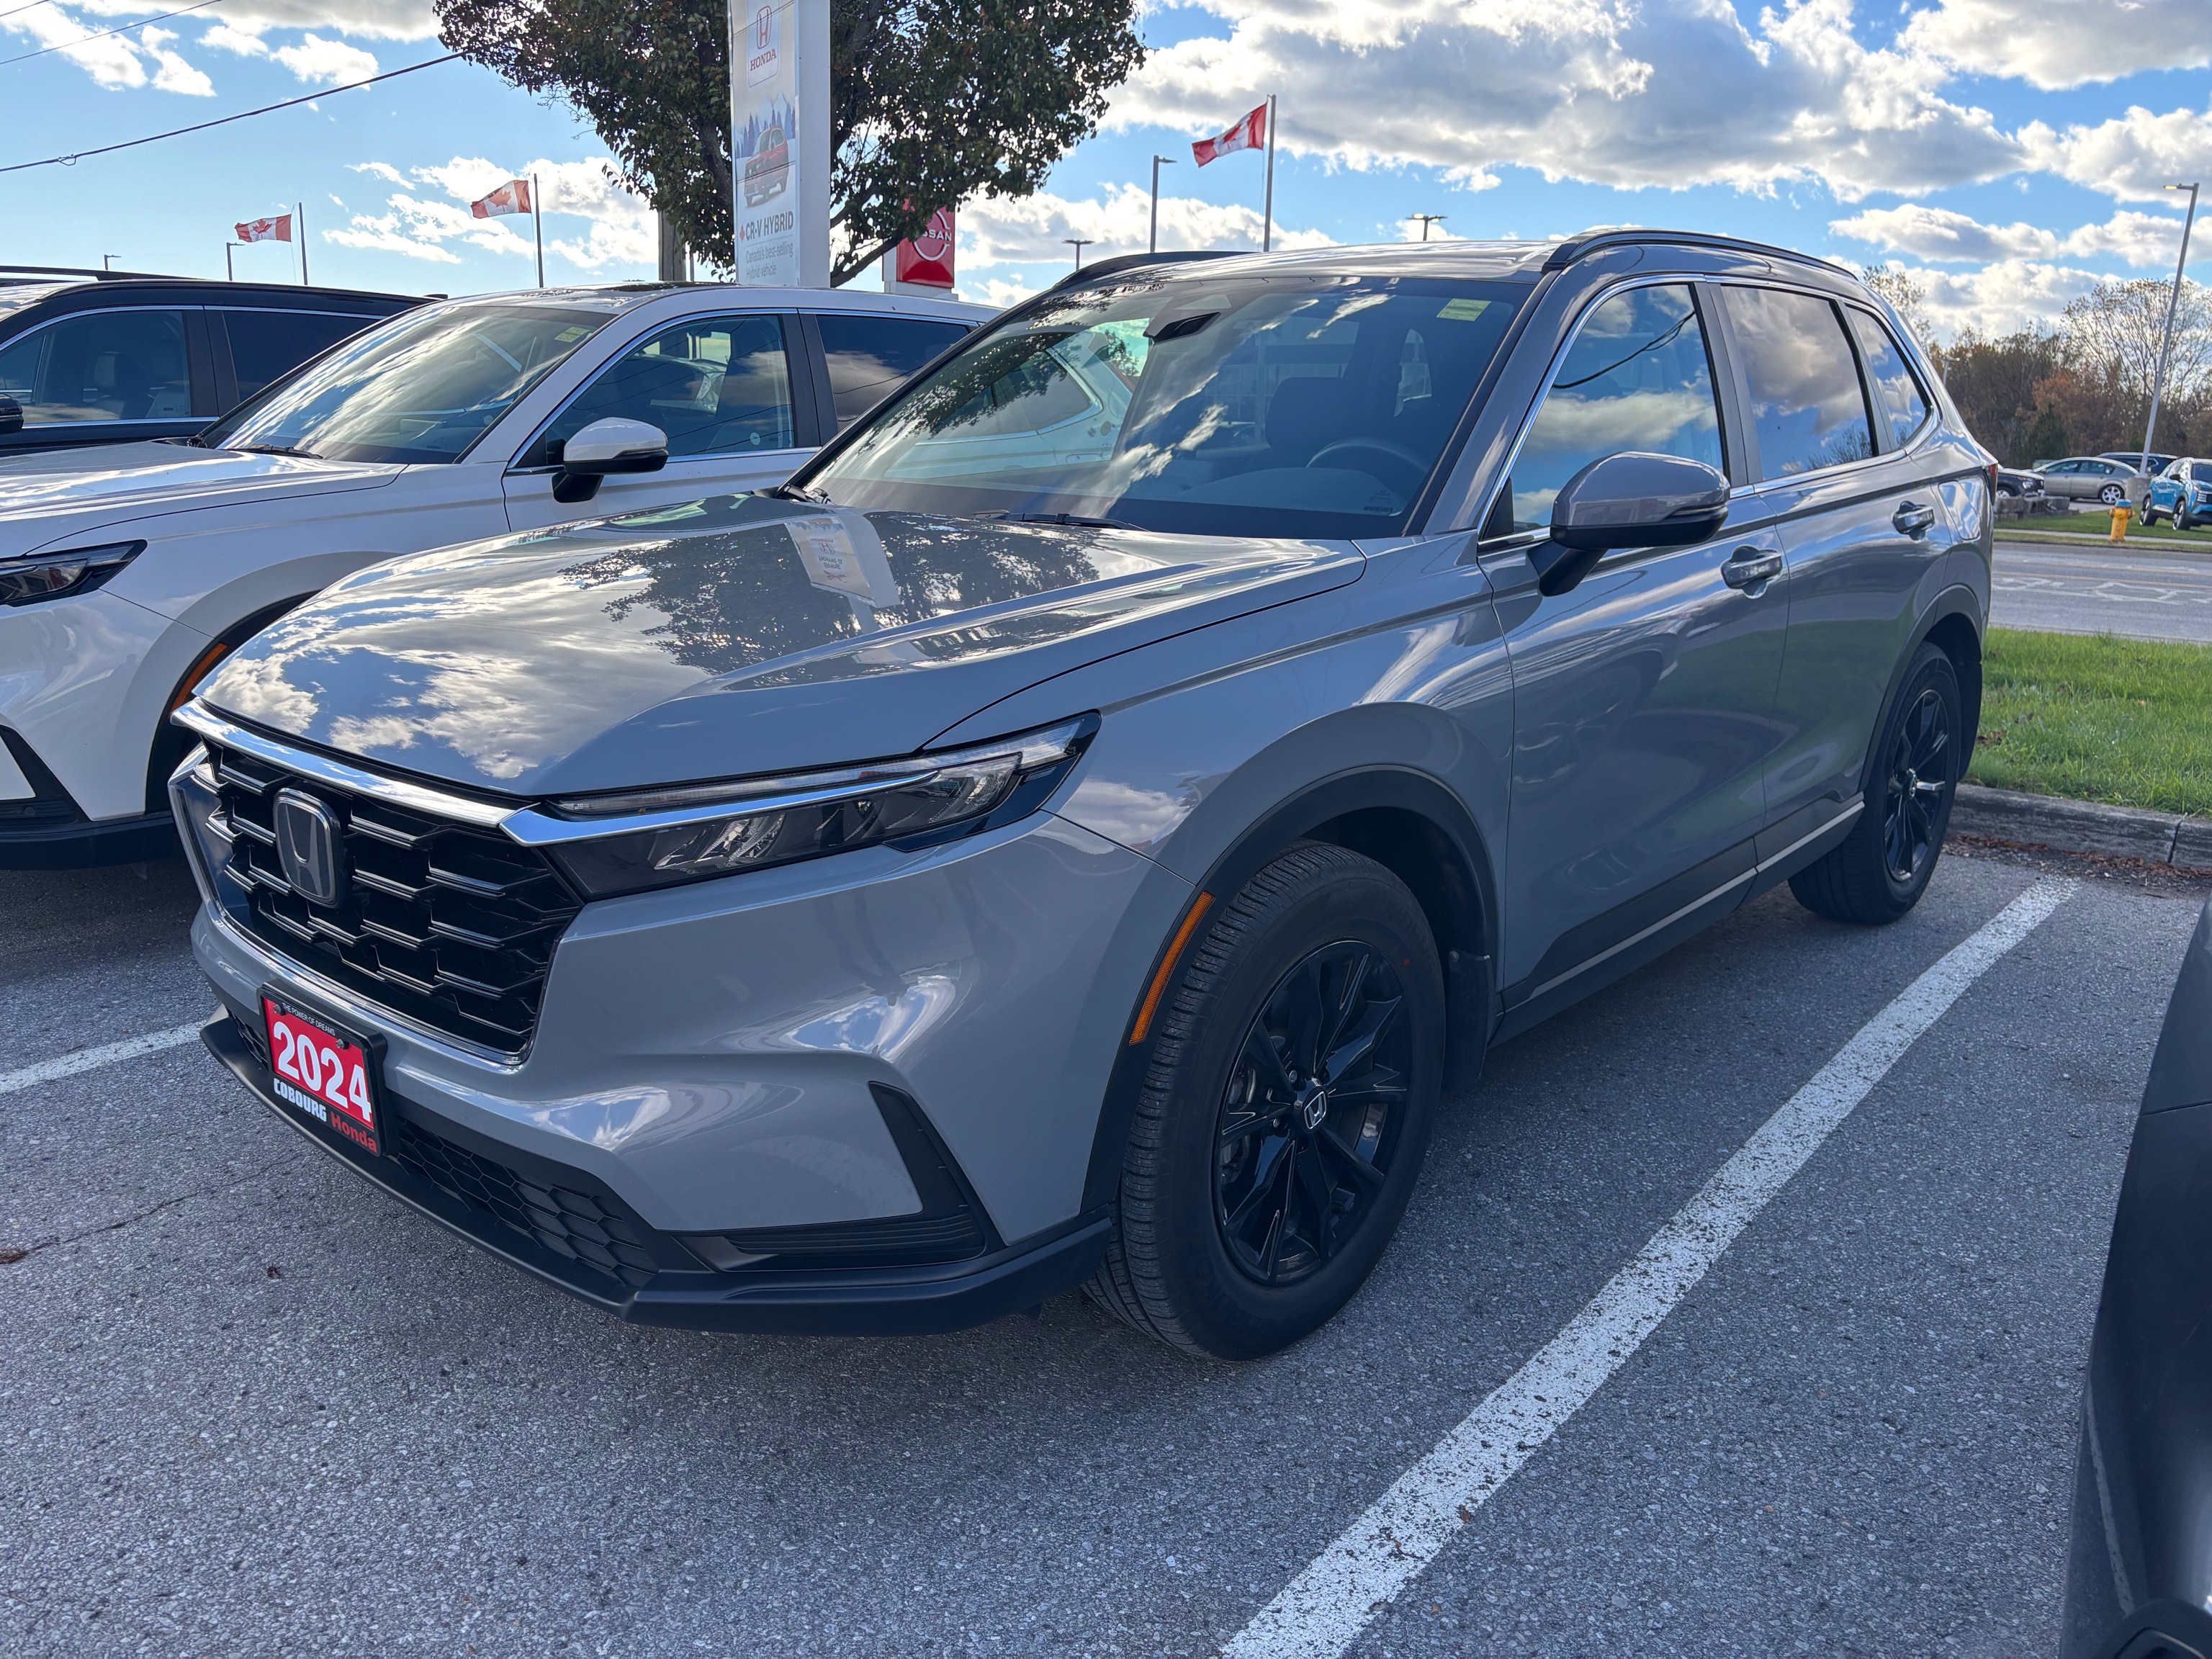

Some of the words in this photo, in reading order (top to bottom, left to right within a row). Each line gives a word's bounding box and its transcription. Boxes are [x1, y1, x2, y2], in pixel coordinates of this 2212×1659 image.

[750, 48, 777, 71] HONDA
[764, 211, 793, 236] HYBRID
[746, 246, 765, 264] Canada's
[765, 241, 793, 257] best-selling
[761, 261, 777, 276] vehicle
[282, 1002, 292, 1013] THE
[292, 1007, 310, 1022] POWER
[307, 1016, 316, 1025] OF
[316, 1020, 336, 1036] DREAMS
[274, 1021, 372, 1123] 2024
[274, 1077, 327, 1123] COBOURG
[330, 1110, 378, 1153] Honda
